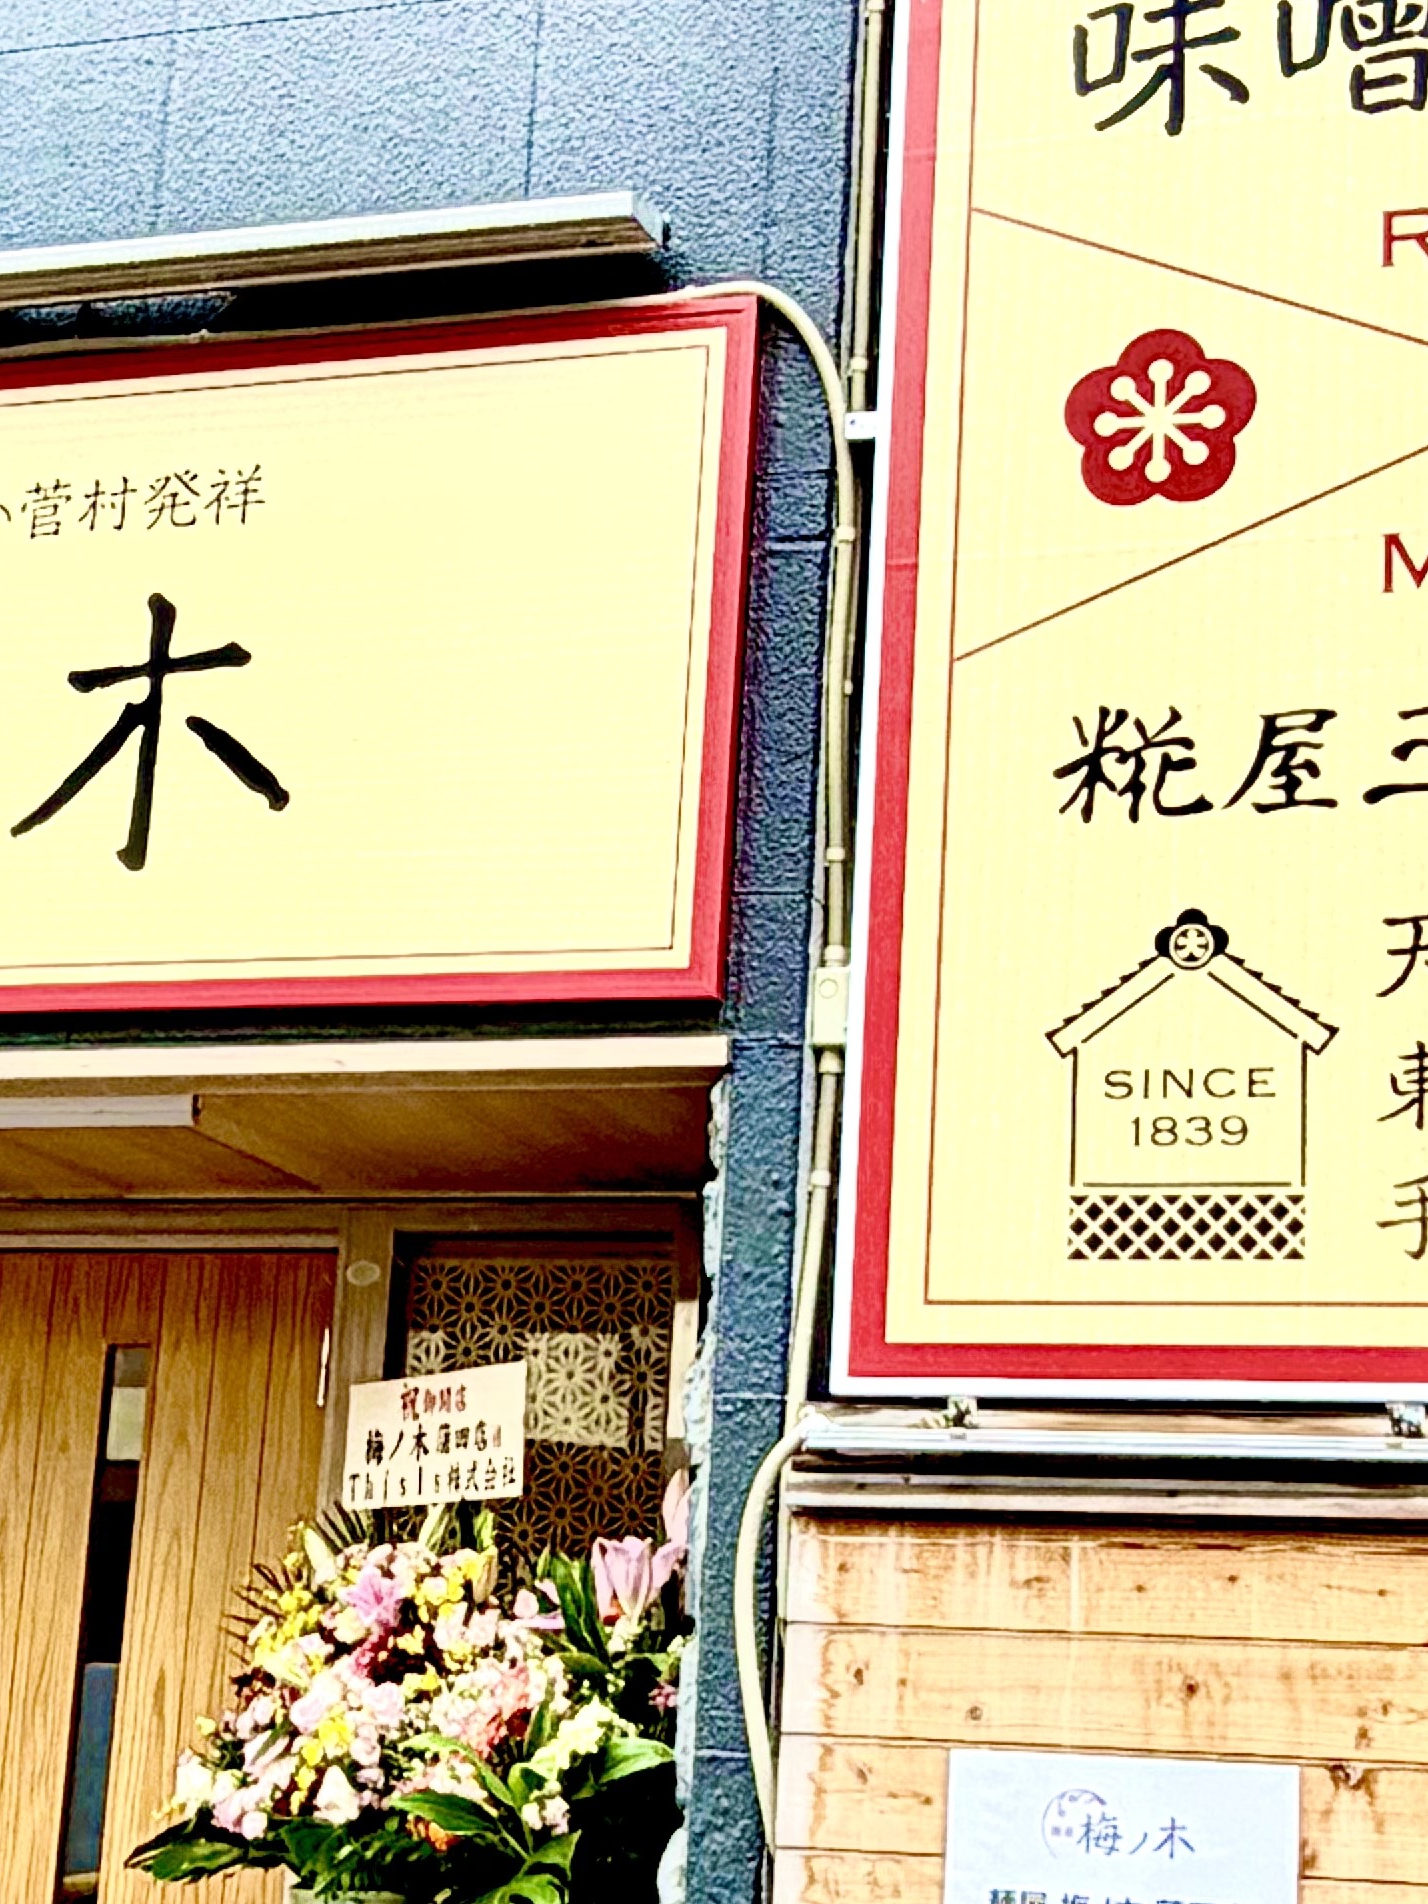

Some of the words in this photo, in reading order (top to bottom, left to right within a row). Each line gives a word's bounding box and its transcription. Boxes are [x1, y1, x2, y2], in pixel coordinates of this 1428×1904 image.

[1103, 1066, 1276, 1100] SINCE
[1131, 1115, 1249, 1147] 1839
[1077, 1812, 1195, 1859] 梅ノ木
